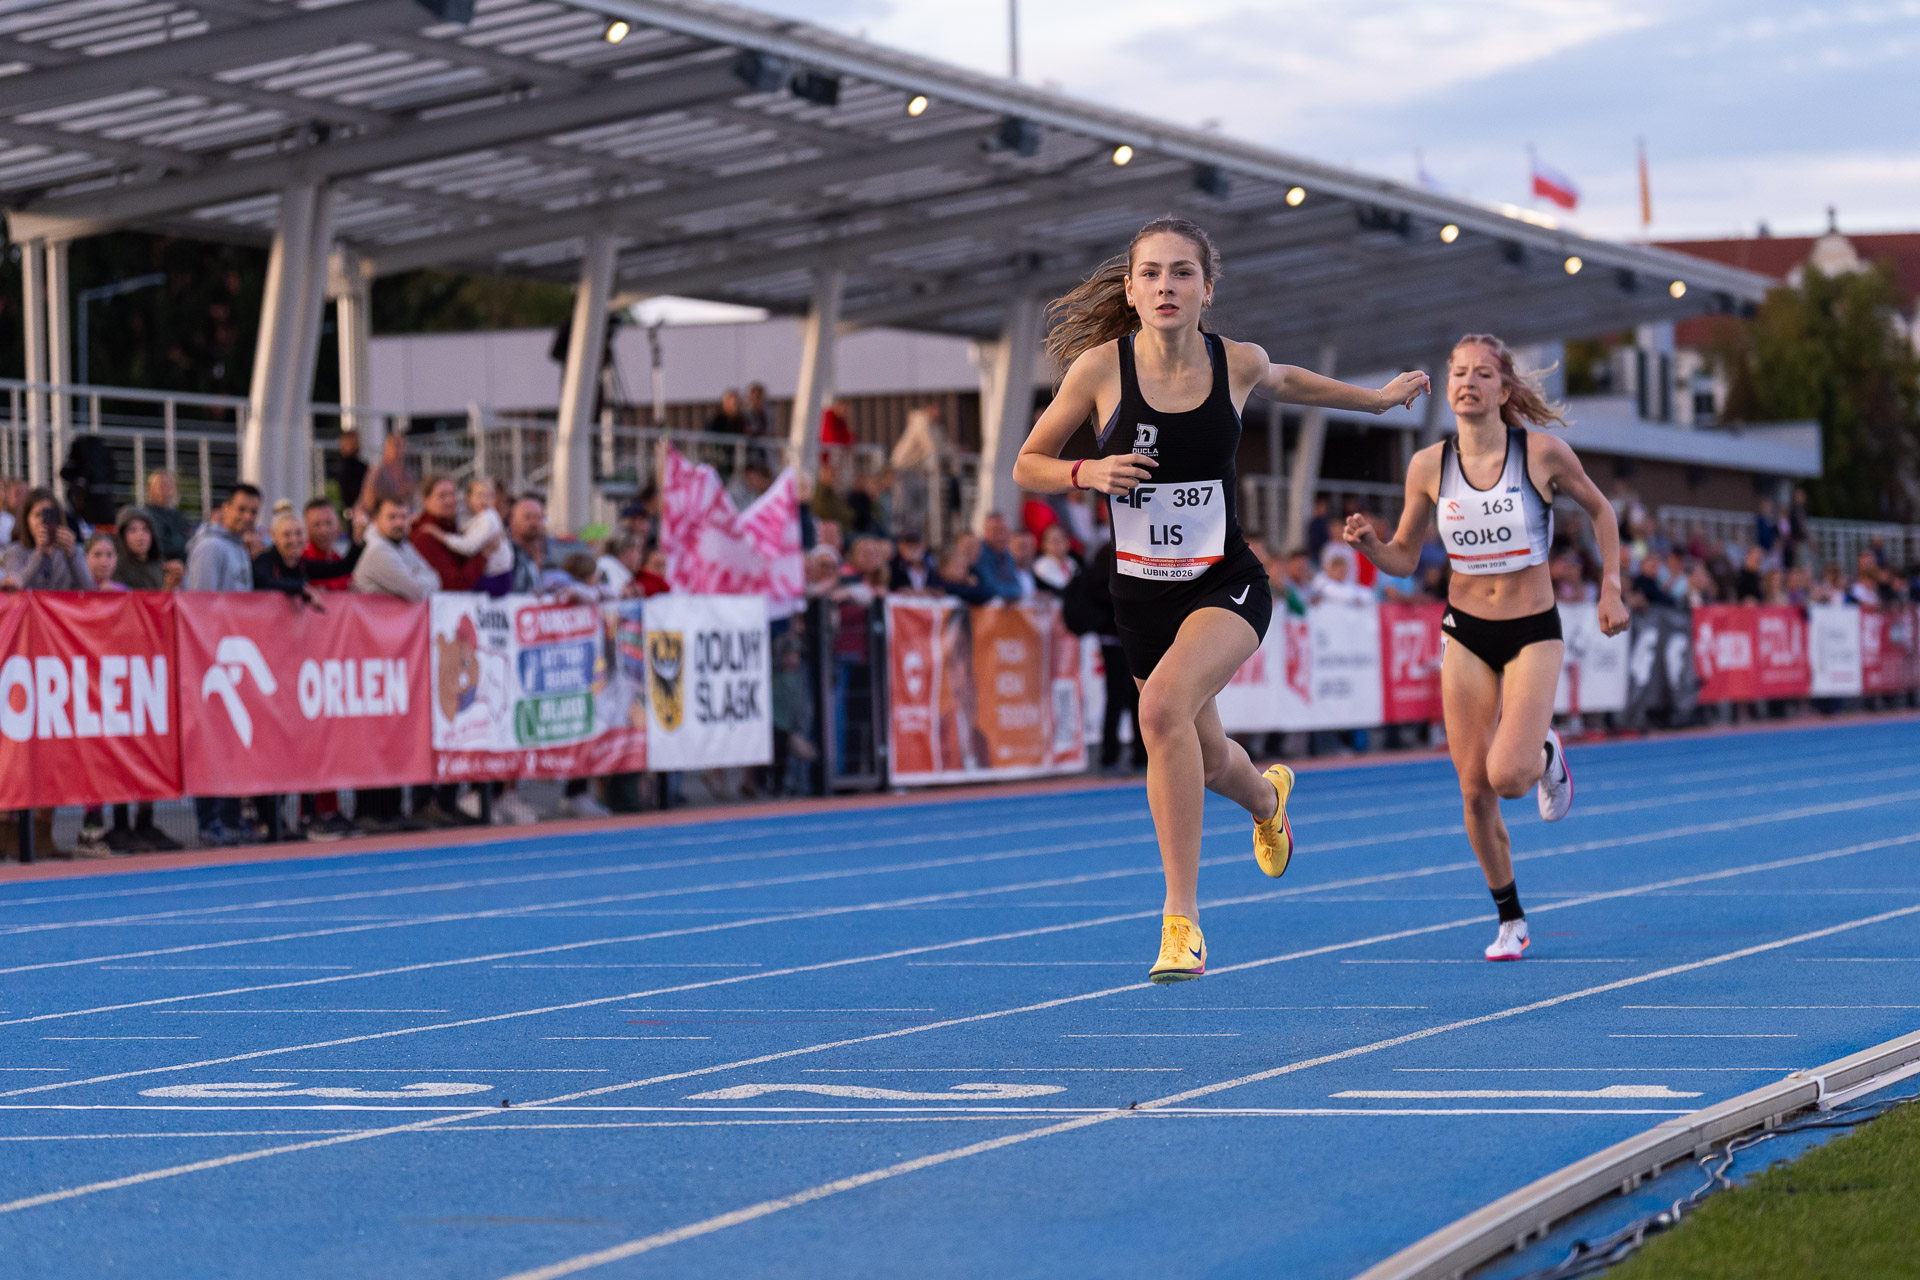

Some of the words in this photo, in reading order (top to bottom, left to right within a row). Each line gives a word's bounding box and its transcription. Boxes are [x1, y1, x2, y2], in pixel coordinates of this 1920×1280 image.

[1173, 487, 1213, 507] 387
[1482, 498, 1514, 515] 163
[1150, 525, 1183, 545] LIS
[1452, 526, 1512, 546] GOJŁO
[1142, 568, 1168, 577] LUBIN
[1170, 569, 1193, 577] 2026
[0, 654, 169, 742] ORLEN
[299, 657, 408, 720] ORLEN
